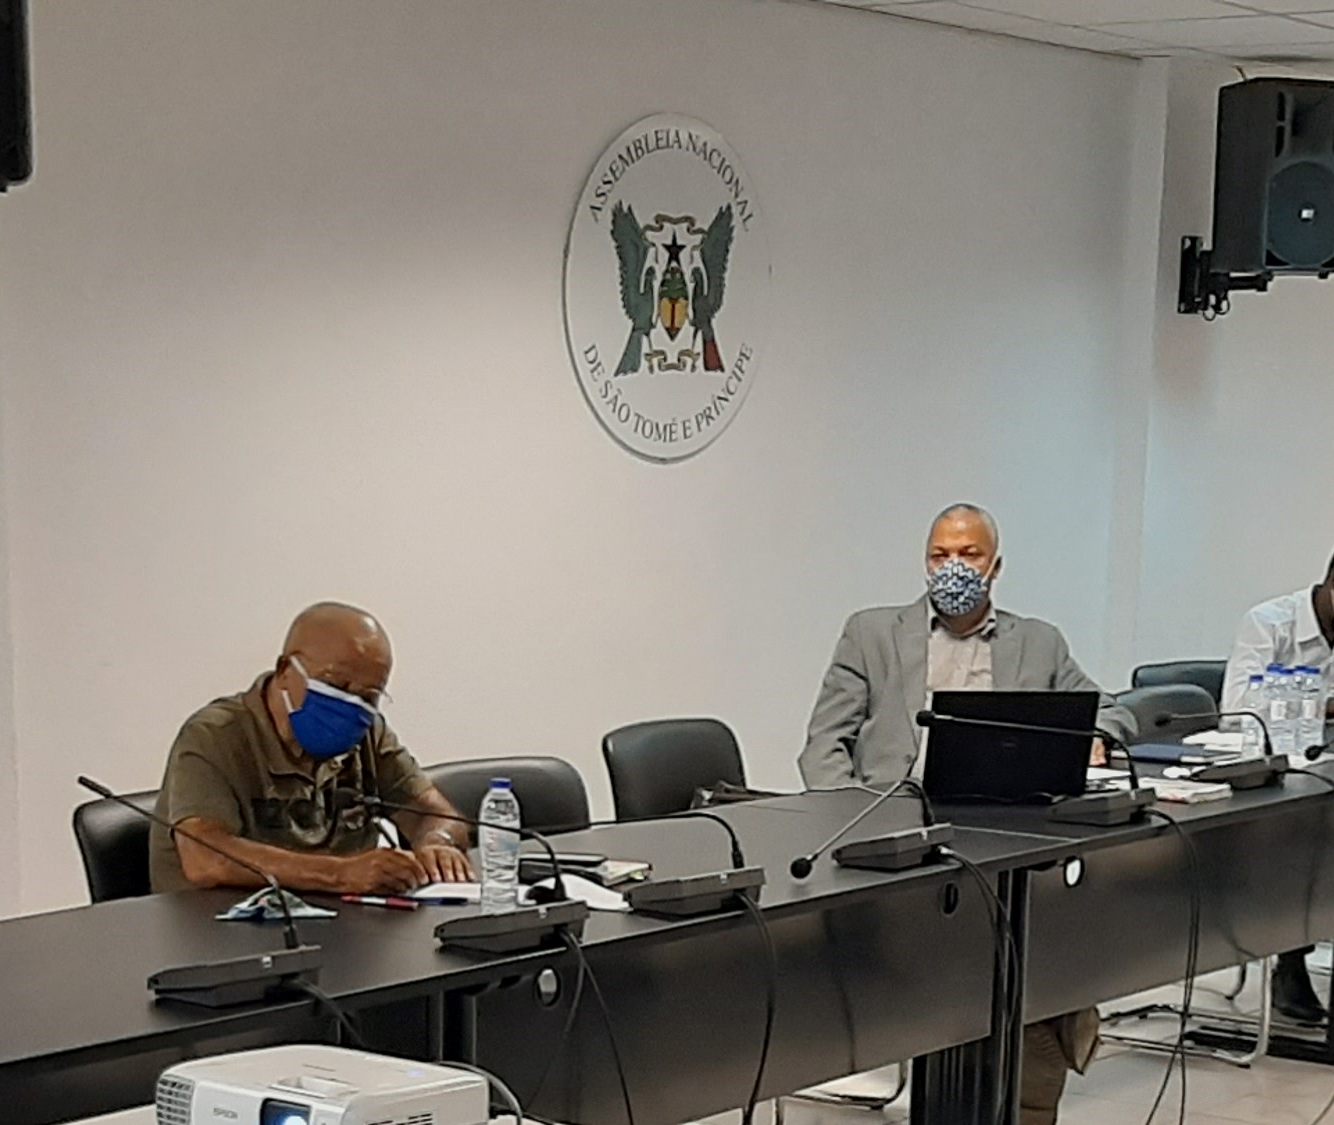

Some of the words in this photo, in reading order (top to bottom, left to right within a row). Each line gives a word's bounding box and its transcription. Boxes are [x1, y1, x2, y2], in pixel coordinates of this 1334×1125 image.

[587, 128, 682, 223] ASSEMBLEIA
[685, 131, 754, 233] NACIONAL
[583, 344, 605, 382] DE
[599, 380, 631, 423] SÃO
[633, 412, 679, 443] TOMÉ
[681, 419, 693, 440] E
